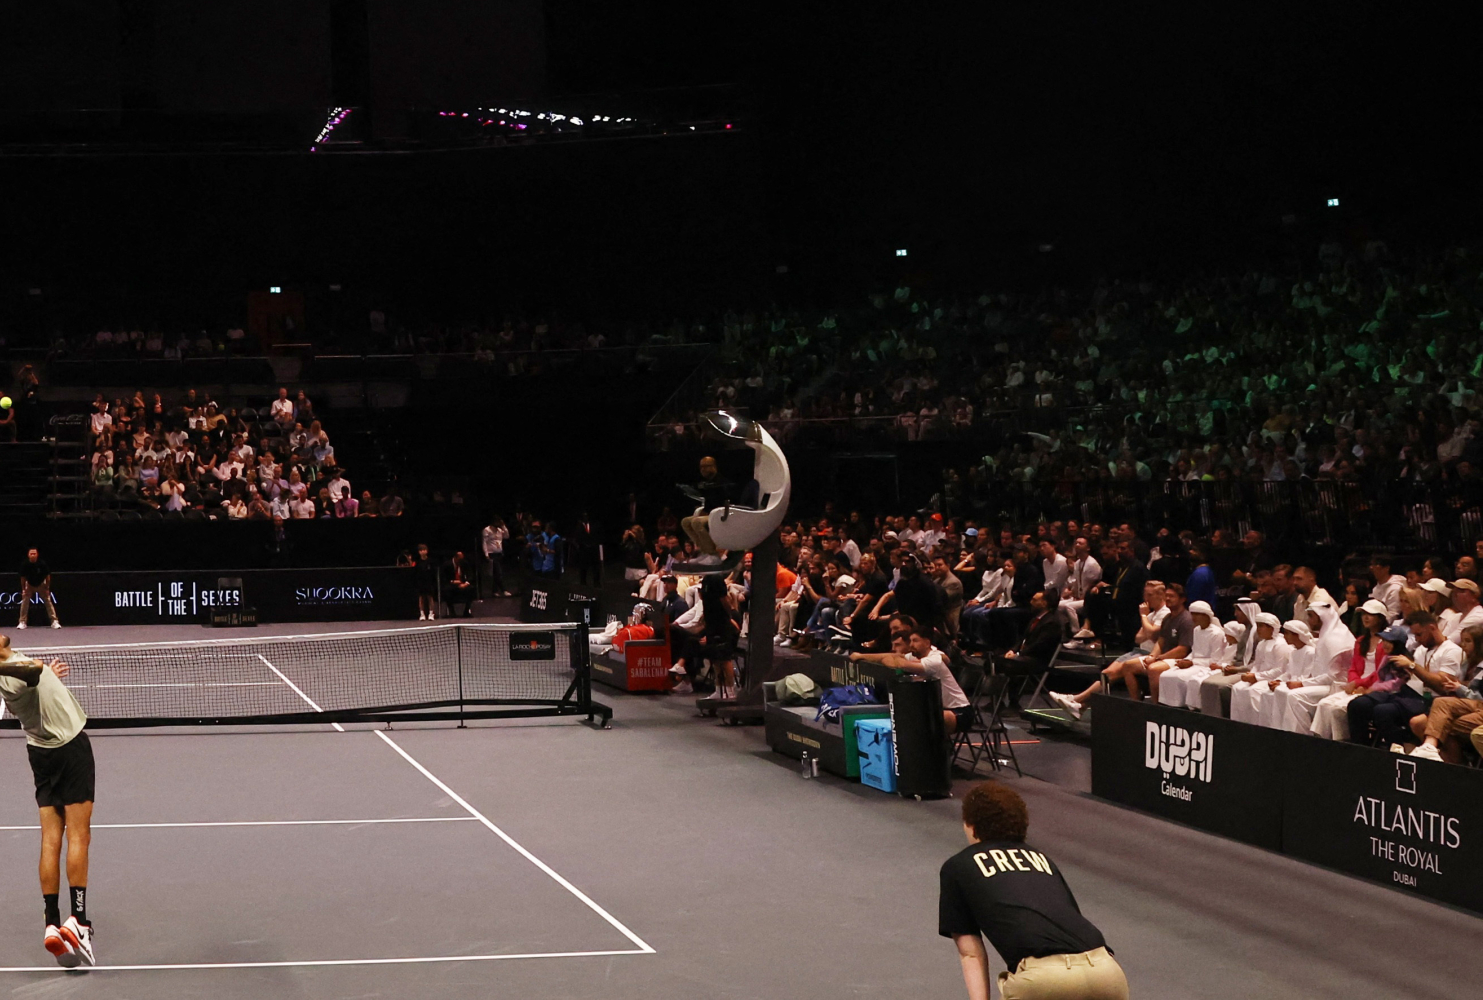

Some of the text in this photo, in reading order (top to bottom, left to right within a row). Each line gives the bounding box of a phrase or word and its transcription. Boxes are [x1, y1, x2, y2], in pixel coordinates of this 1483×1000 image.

[115, 581, 240, 616] BATTLE OF THE SEXES
[1145, 721, 1214, 784] DUBAI
[1161, 779, 1193, 802] Calendar
[1353, 796, 1460, 848] ATLANTIS
[973, 848, 1053, 878] CREW
[1369, 836, 1443, 875] THE ROYAL
[1393, 870, 1417, 887] DUBAI
